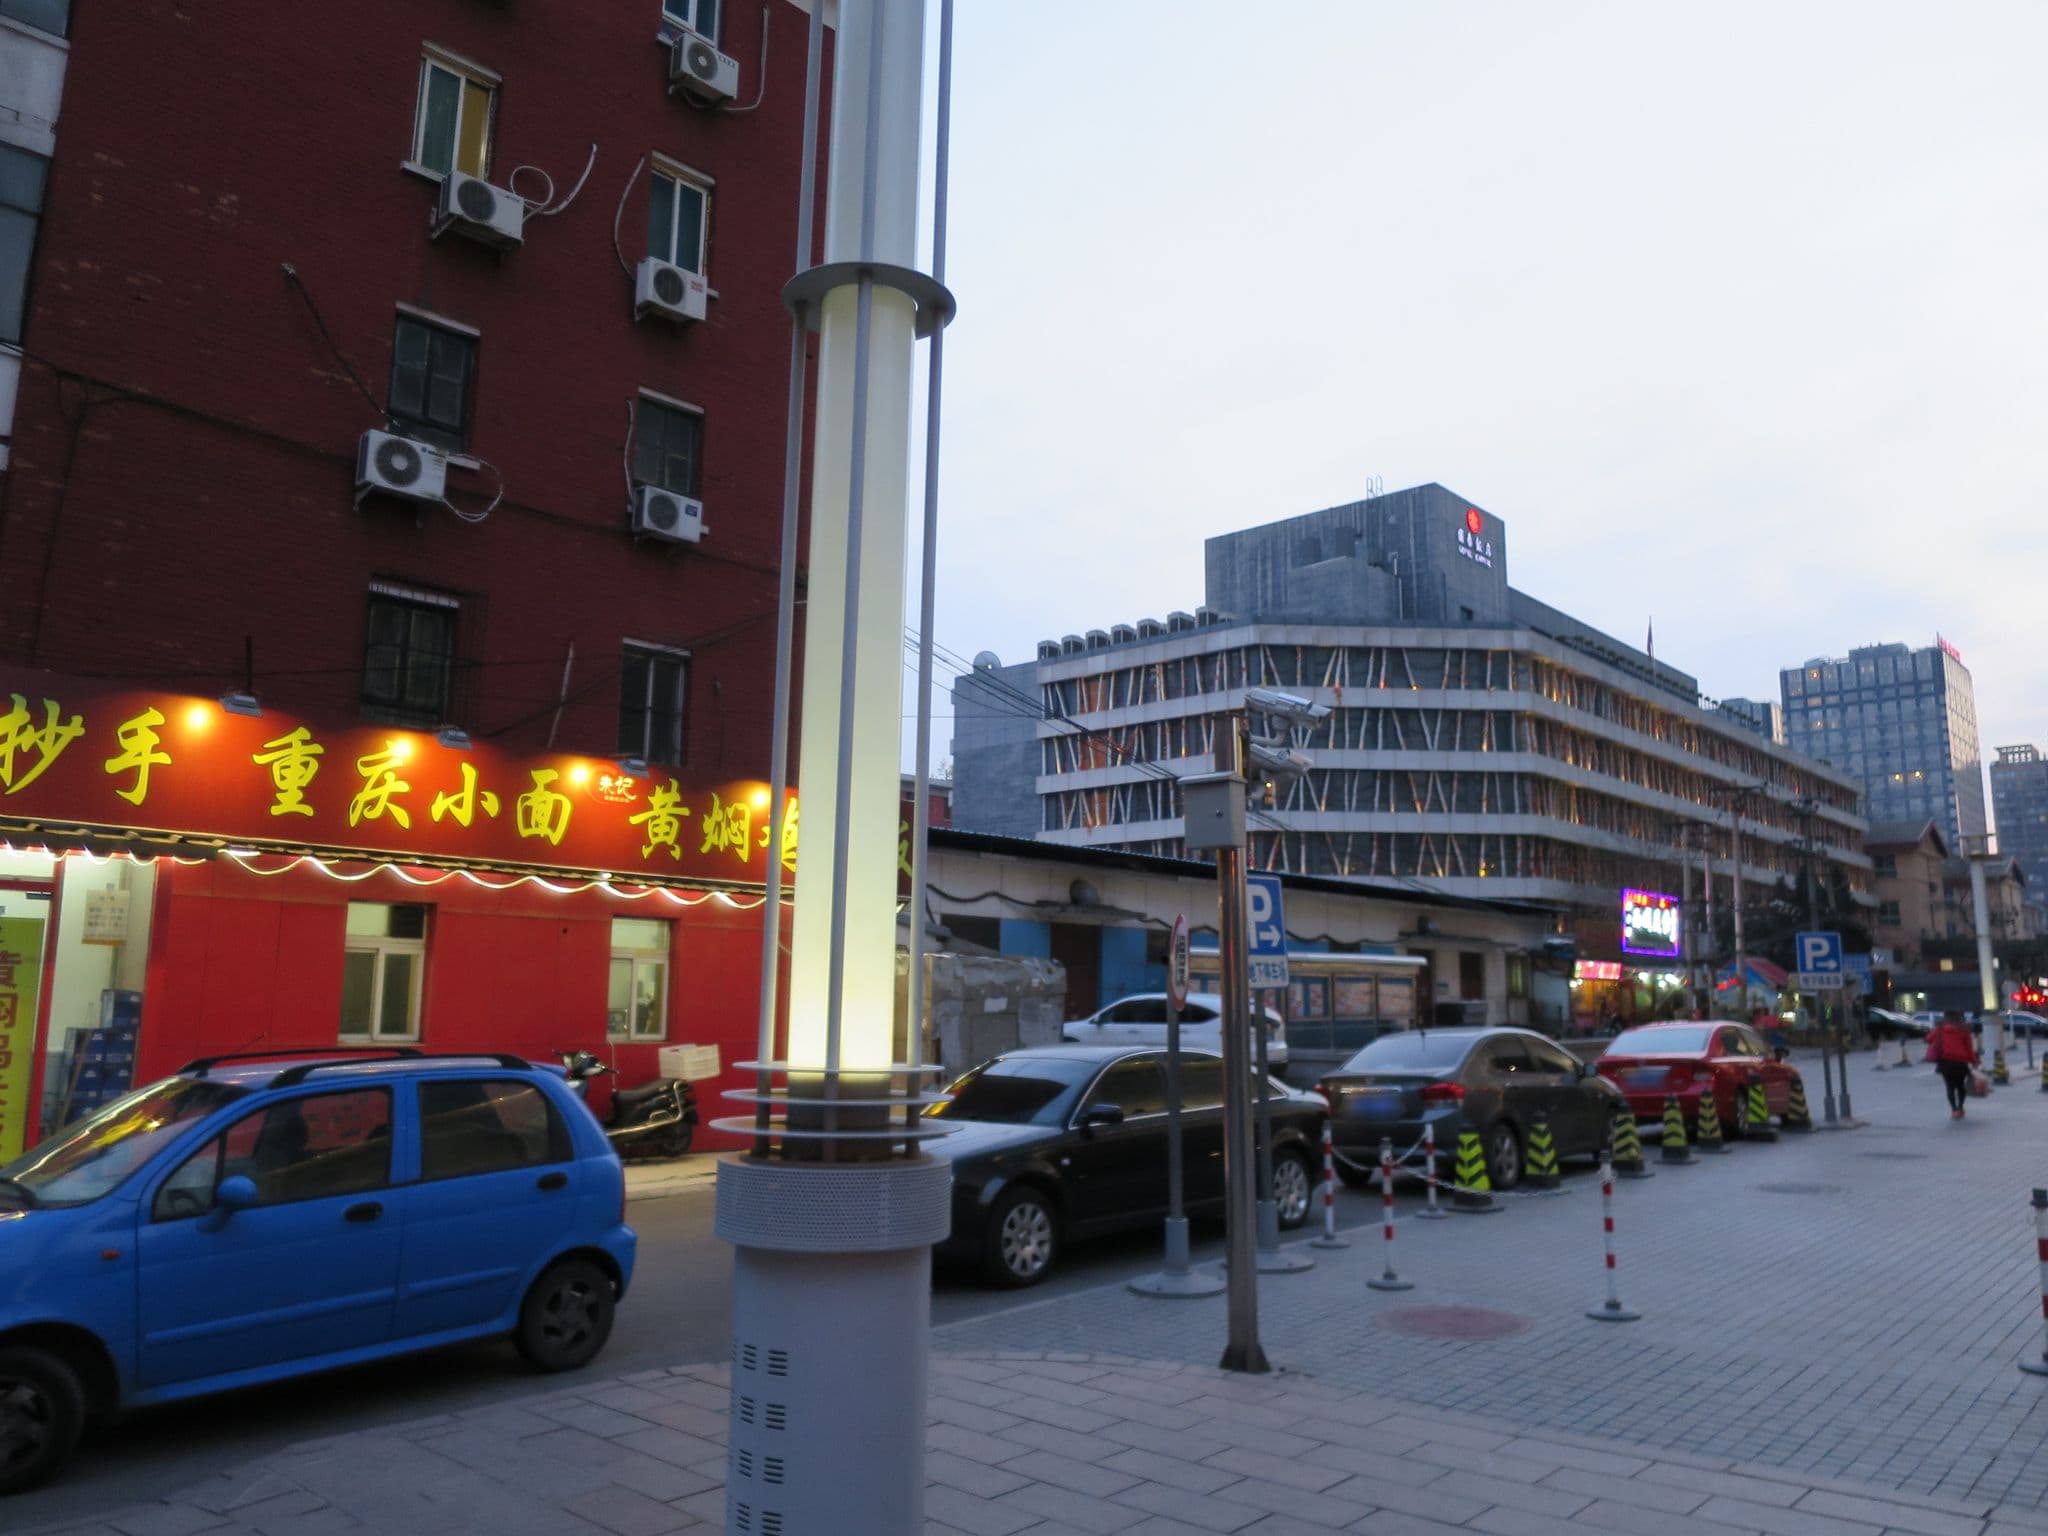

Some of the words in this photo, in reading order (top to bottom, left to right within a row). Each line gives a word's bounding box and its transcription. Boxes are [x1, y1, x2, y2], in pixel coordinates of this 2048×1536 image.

[0, 692, 172, 806] 抄手
[252, 726, 573, 846] 重庆小面
[1247, 884, 1272, 949] P
[1804, 937, 1830, 971] P
